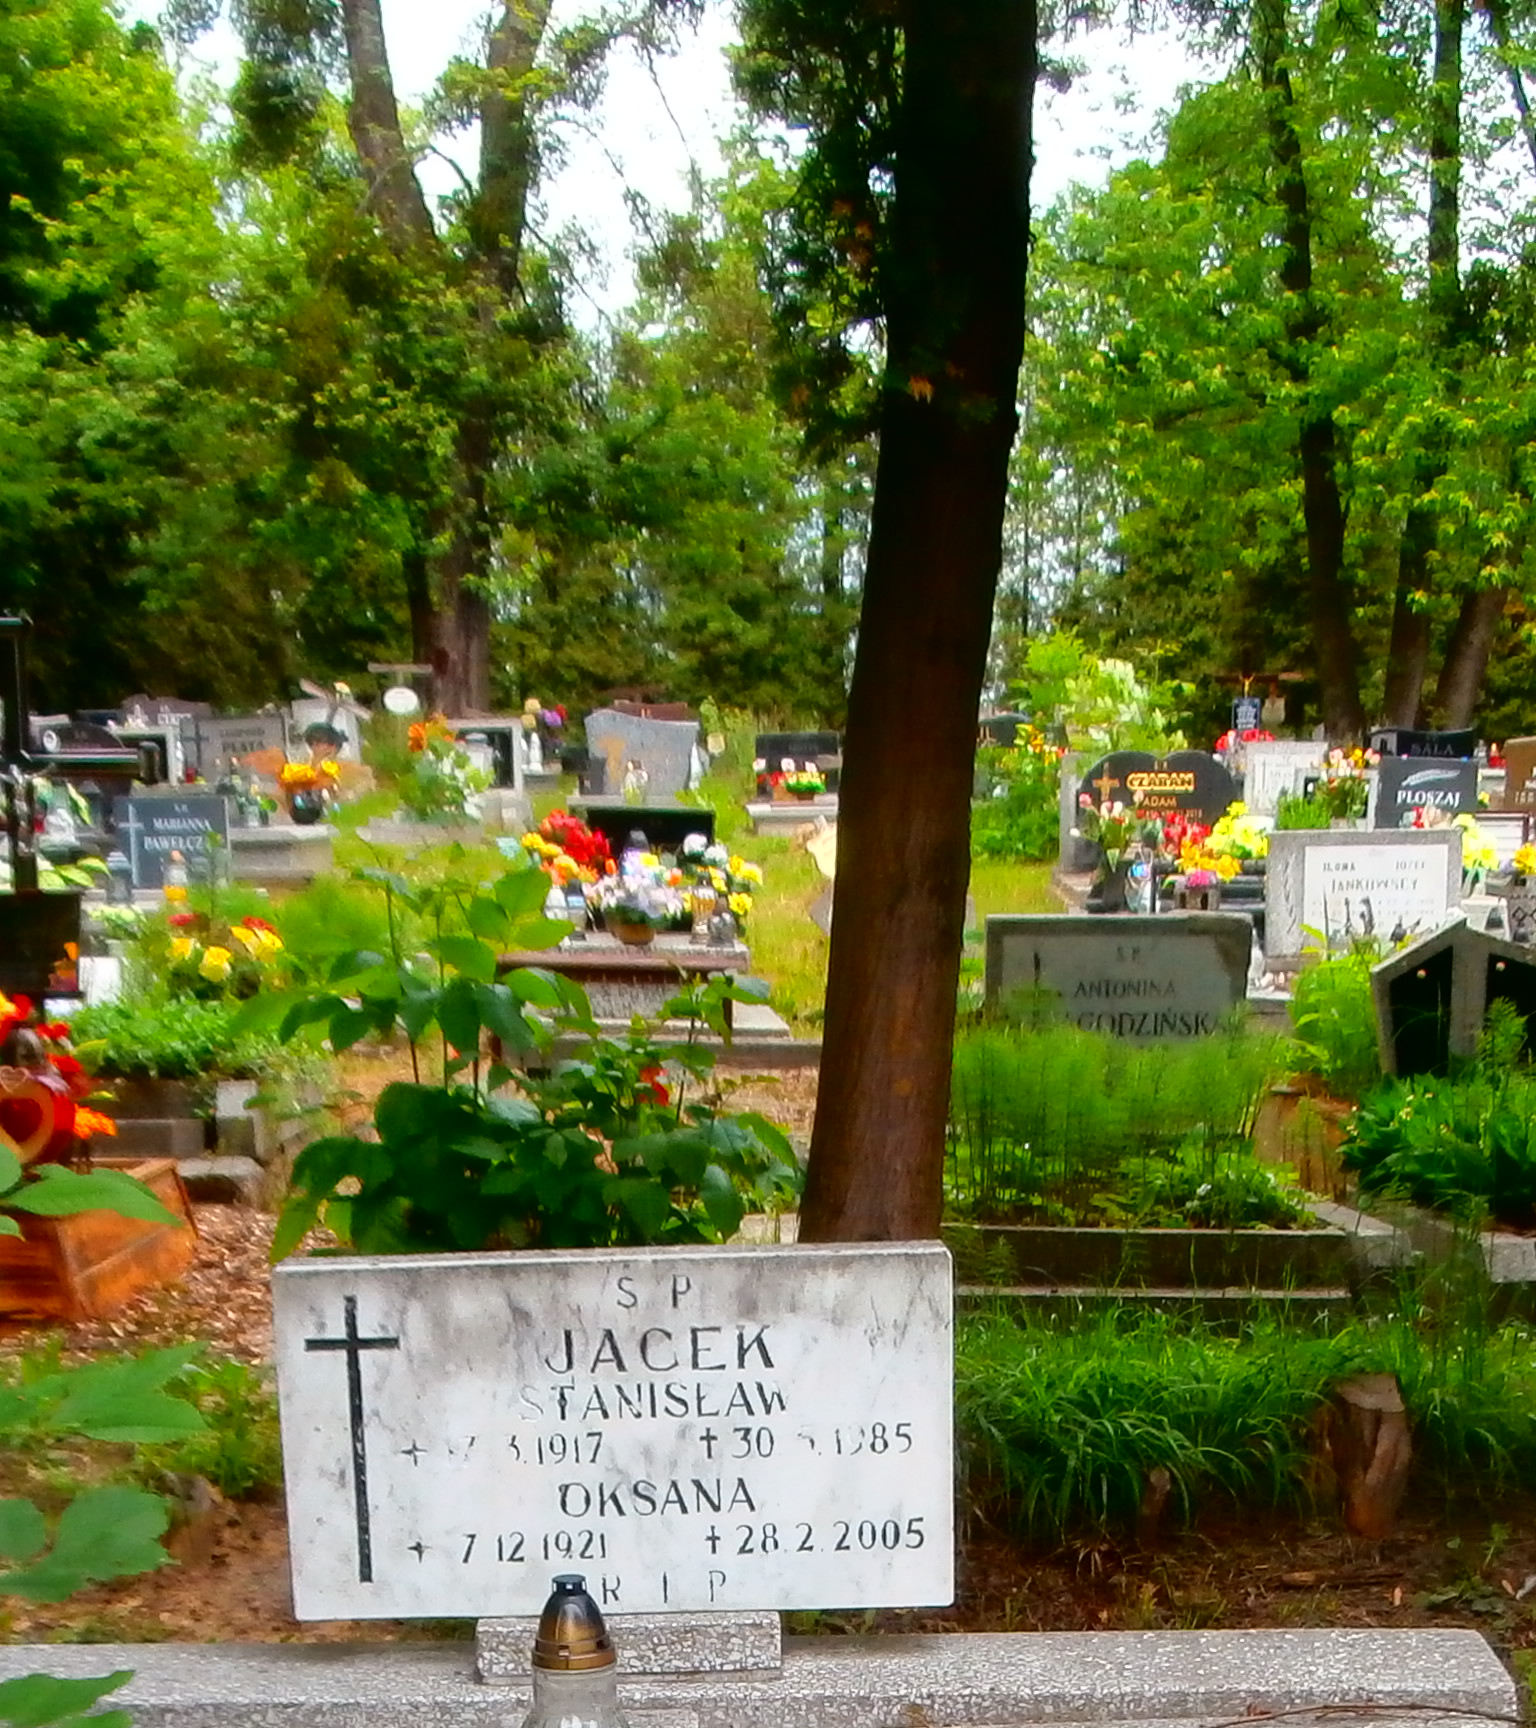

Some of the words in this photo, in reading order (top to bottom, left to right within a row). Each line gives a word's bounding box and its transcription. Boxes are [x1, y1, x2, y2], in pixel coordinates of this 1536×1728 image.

[544, 1324, 775, 1375] JACEK
[519, 1380, 787, 1421] STANISŁAW
[558, 1477, 757, 1518] OKSANA
